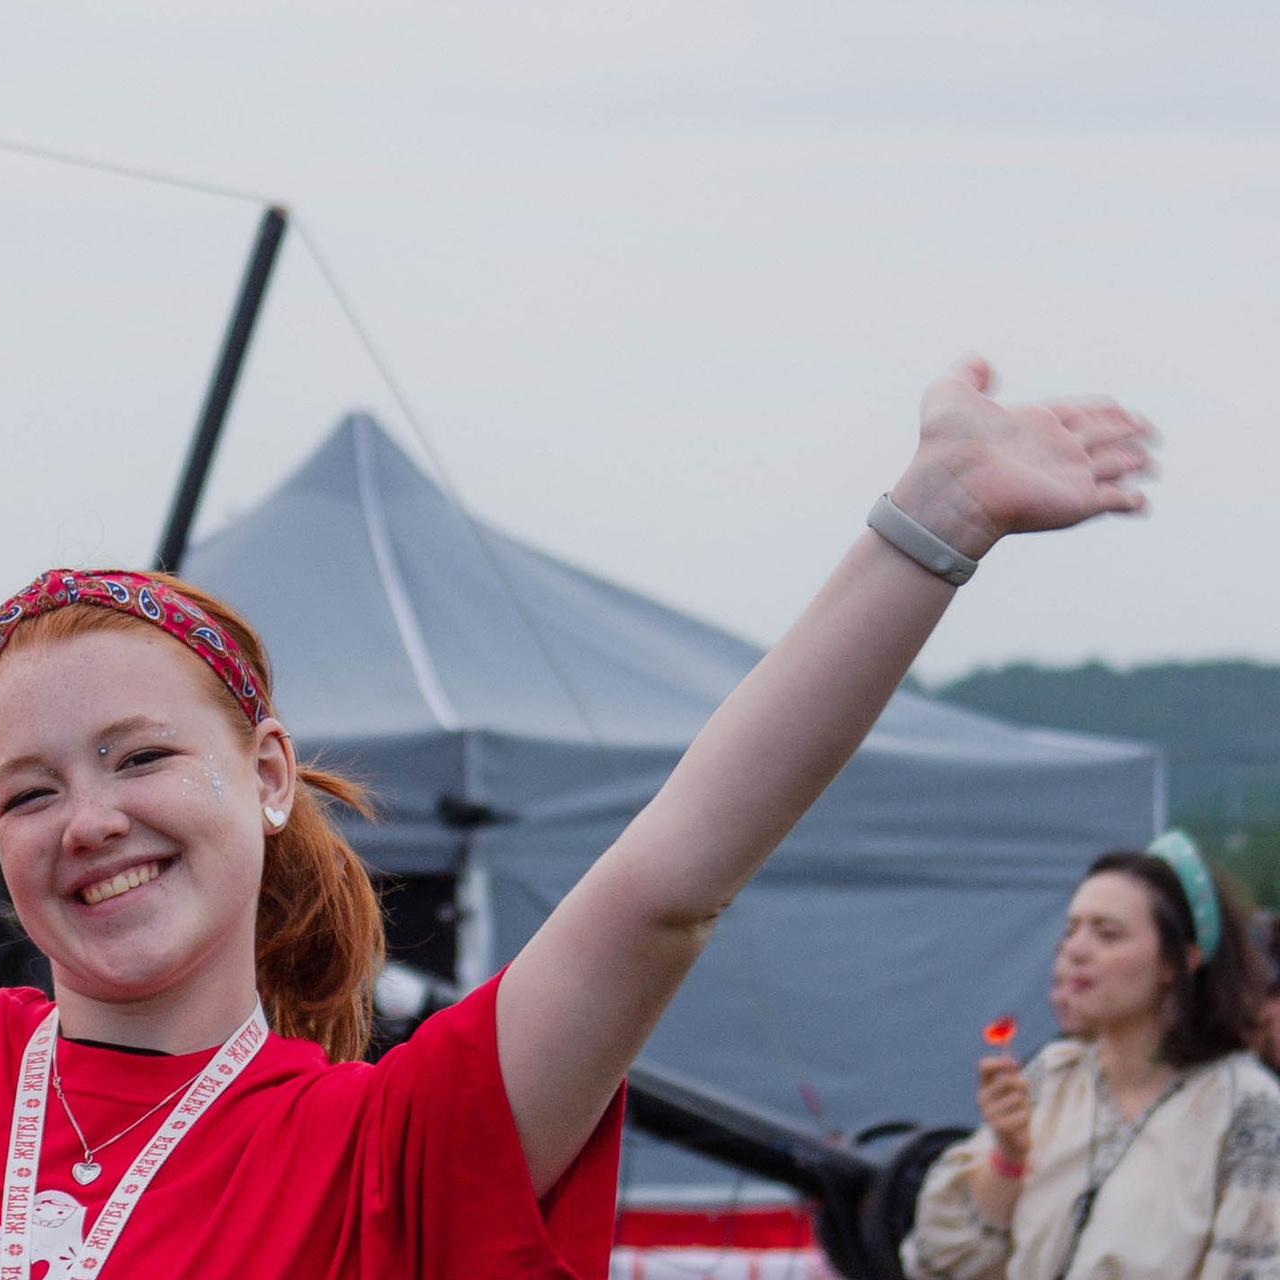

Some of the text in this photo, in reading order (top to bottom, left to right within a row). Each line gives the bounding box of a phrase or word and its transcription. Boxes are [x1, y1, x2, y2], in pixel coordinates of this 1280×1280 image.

[22, 1049, 48, 1092] ЖАТВА
[13, 1116, 39, 1160] ЖАТВА
[86, 1200, 130, 1250] ЖАТВА
[130, 1135, 176, 1178] ЖАТВА
[177, 1075, 223, 1116] ЖАТВА
[224, 1018, 264, 1065] ЖАТВА
[4, 1185, 30, 1235] ЖАТВА
